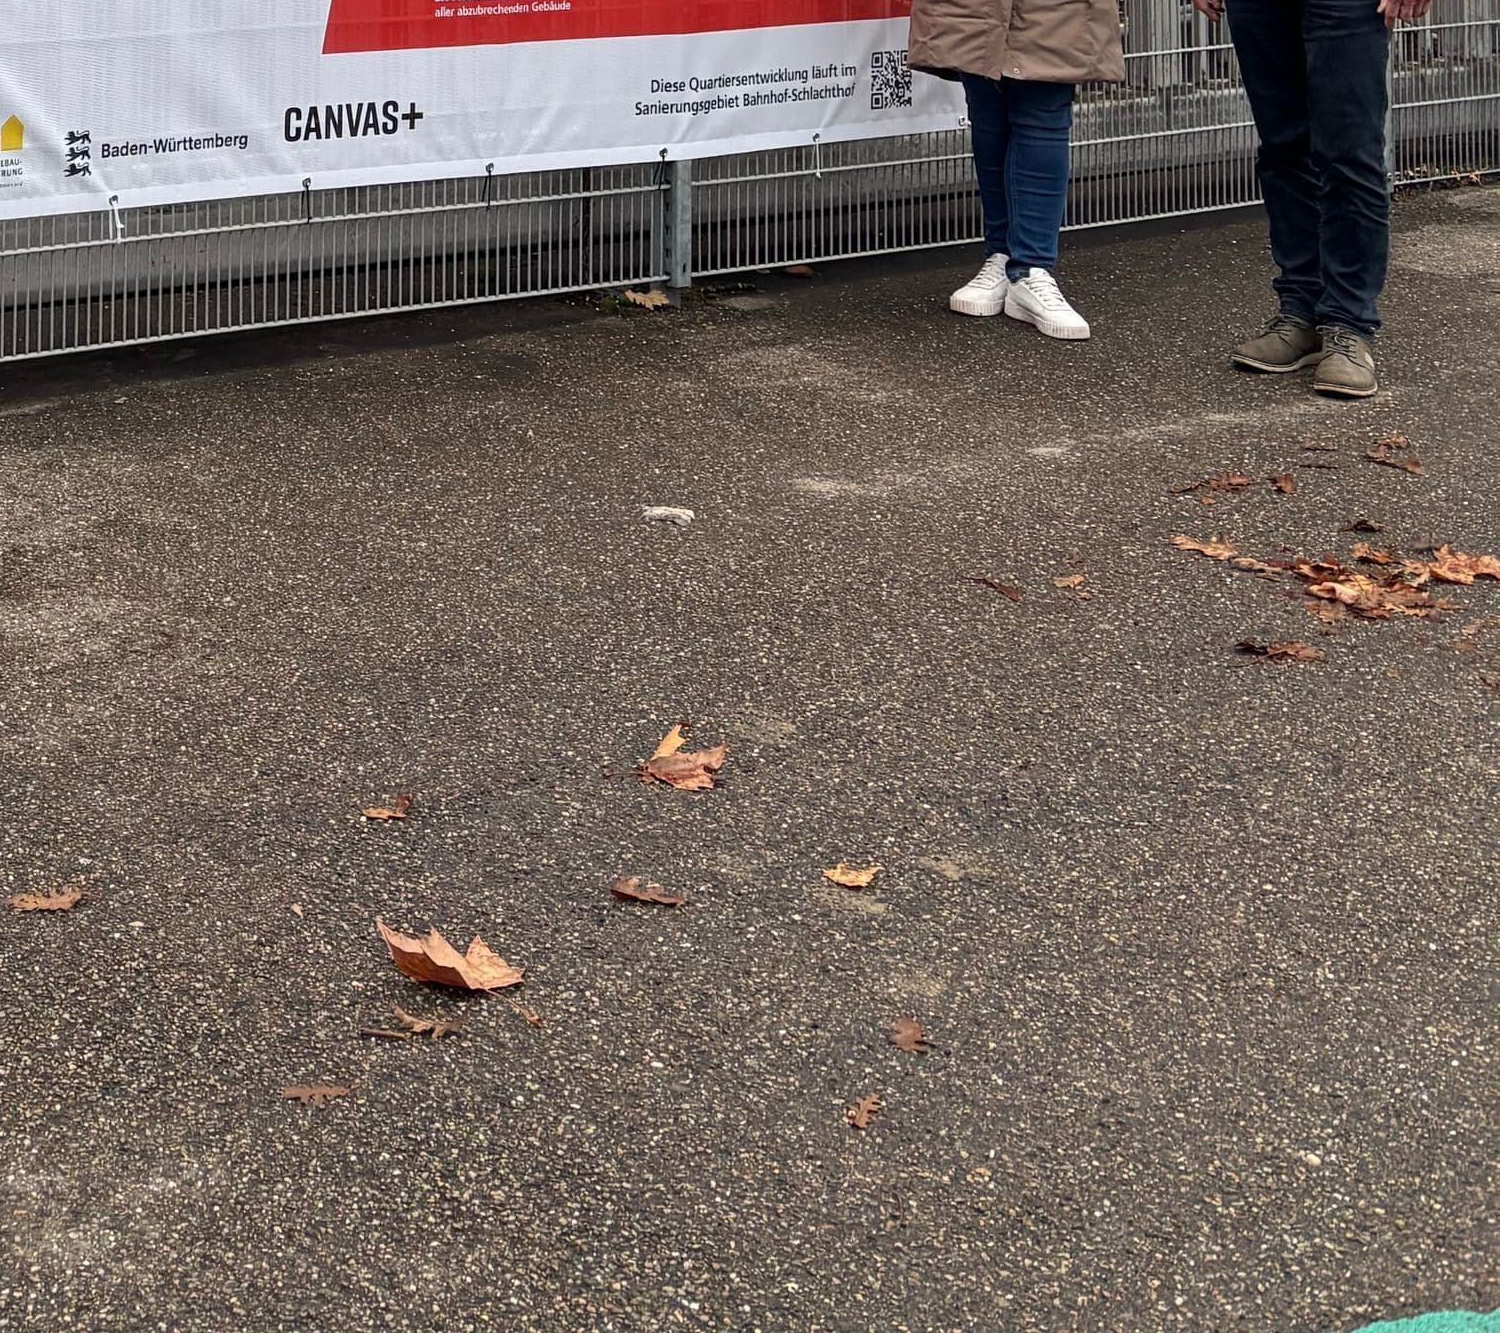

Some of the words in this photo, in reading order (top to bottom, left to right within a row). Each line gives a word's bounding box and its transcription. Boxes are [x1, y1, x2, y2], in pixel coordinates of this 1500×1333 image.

[435, 7, 455, 17] aller
[457, 3, 528, 16] abzubrechenden
[532, 0, 570, 11] Gebäude
[651, 79, 685, 93] Diese
[690, 68, 809, 93] Quartiersentwicklung
[812, 64, 837, 79] läuft
[842, 64, 856, 76] im
[636, 95, 739, 115] Sanierungsgebiet
[743, 82, 856, 107] Bahnhof-Schlachthof
[285, 101, 423, 142] CANVAS+
[102, 133, 248, 158] Baden-Württemberg
